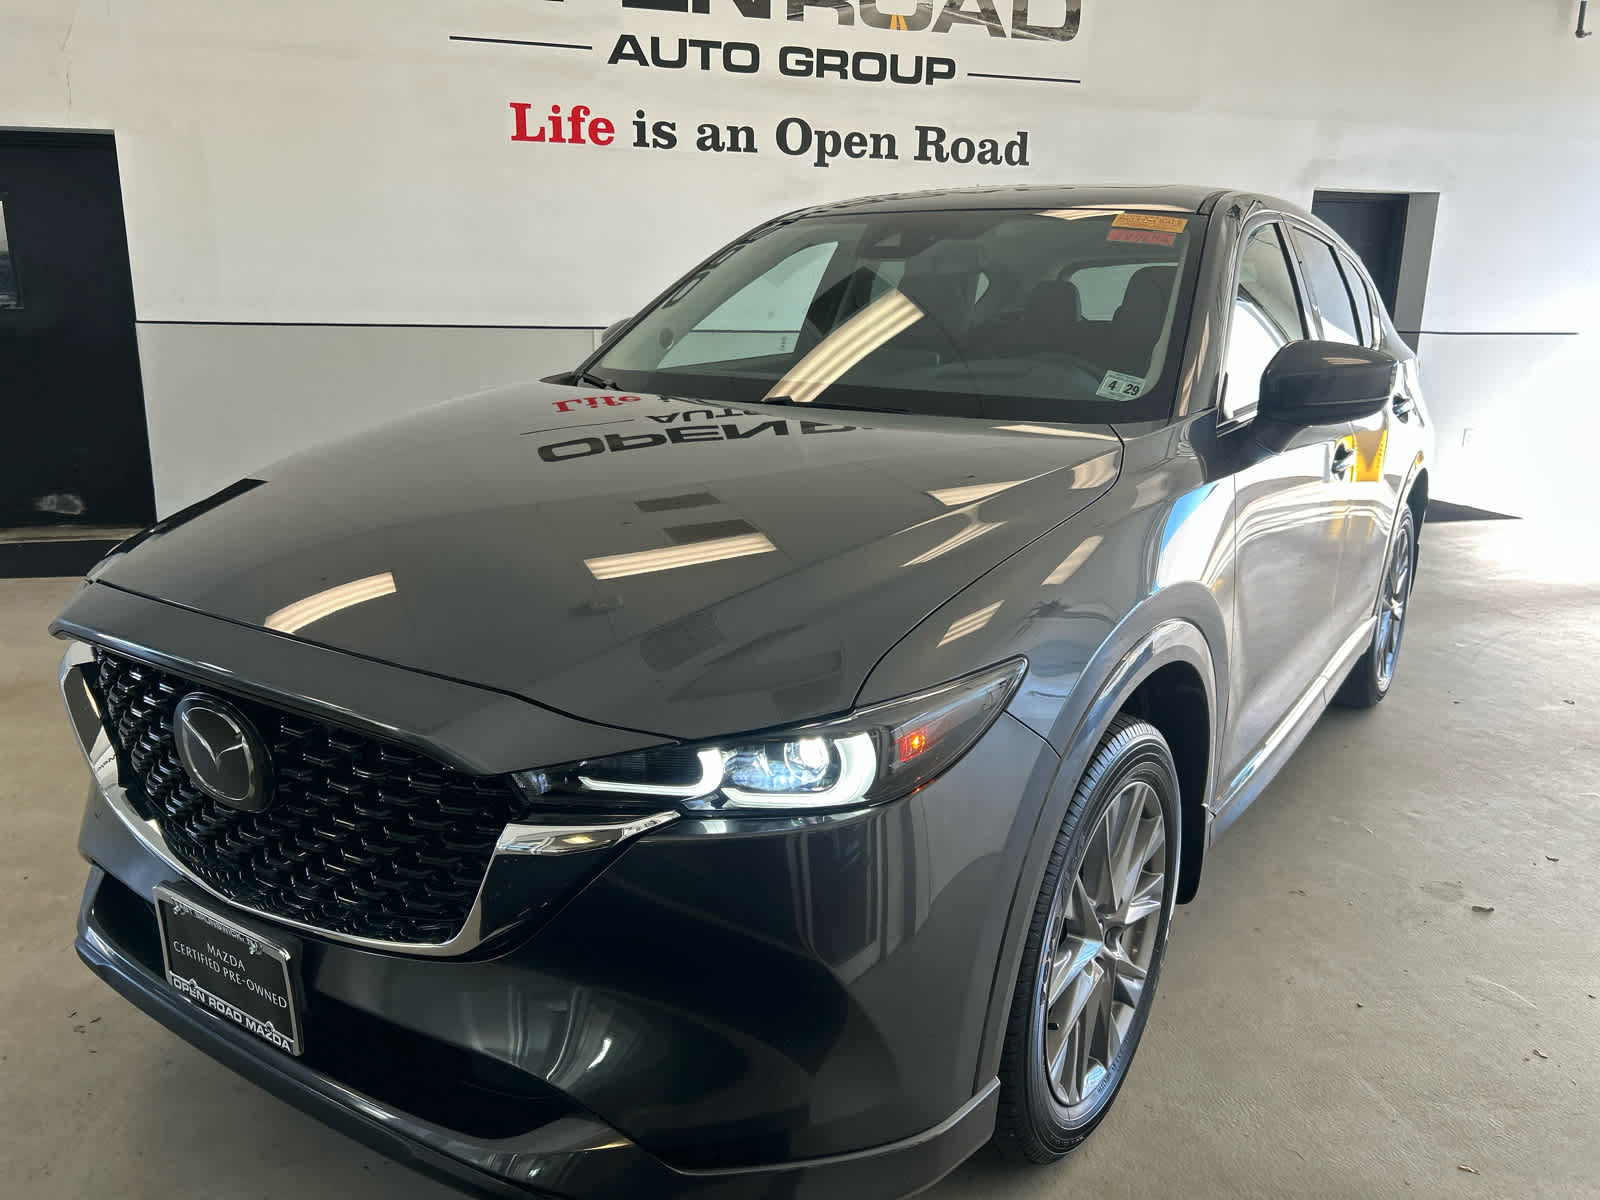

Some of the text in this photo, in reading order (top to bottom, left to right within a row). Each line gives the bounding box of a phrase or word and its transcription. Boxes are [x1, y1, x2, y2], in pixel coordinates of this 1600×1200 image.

[607, 34, 956, 86] AUTO GROUP
[509, 102, 1030, 168] Life is an Open Road
[1108, 380, 1140, 396] 4 29
[173, 940, 288, 1009] CERTIFIED PRE-OWNED
[206, 942, 246, 972] MAZDA
[173, 977, 292, 1052] OPEN ROAD MAZDA
